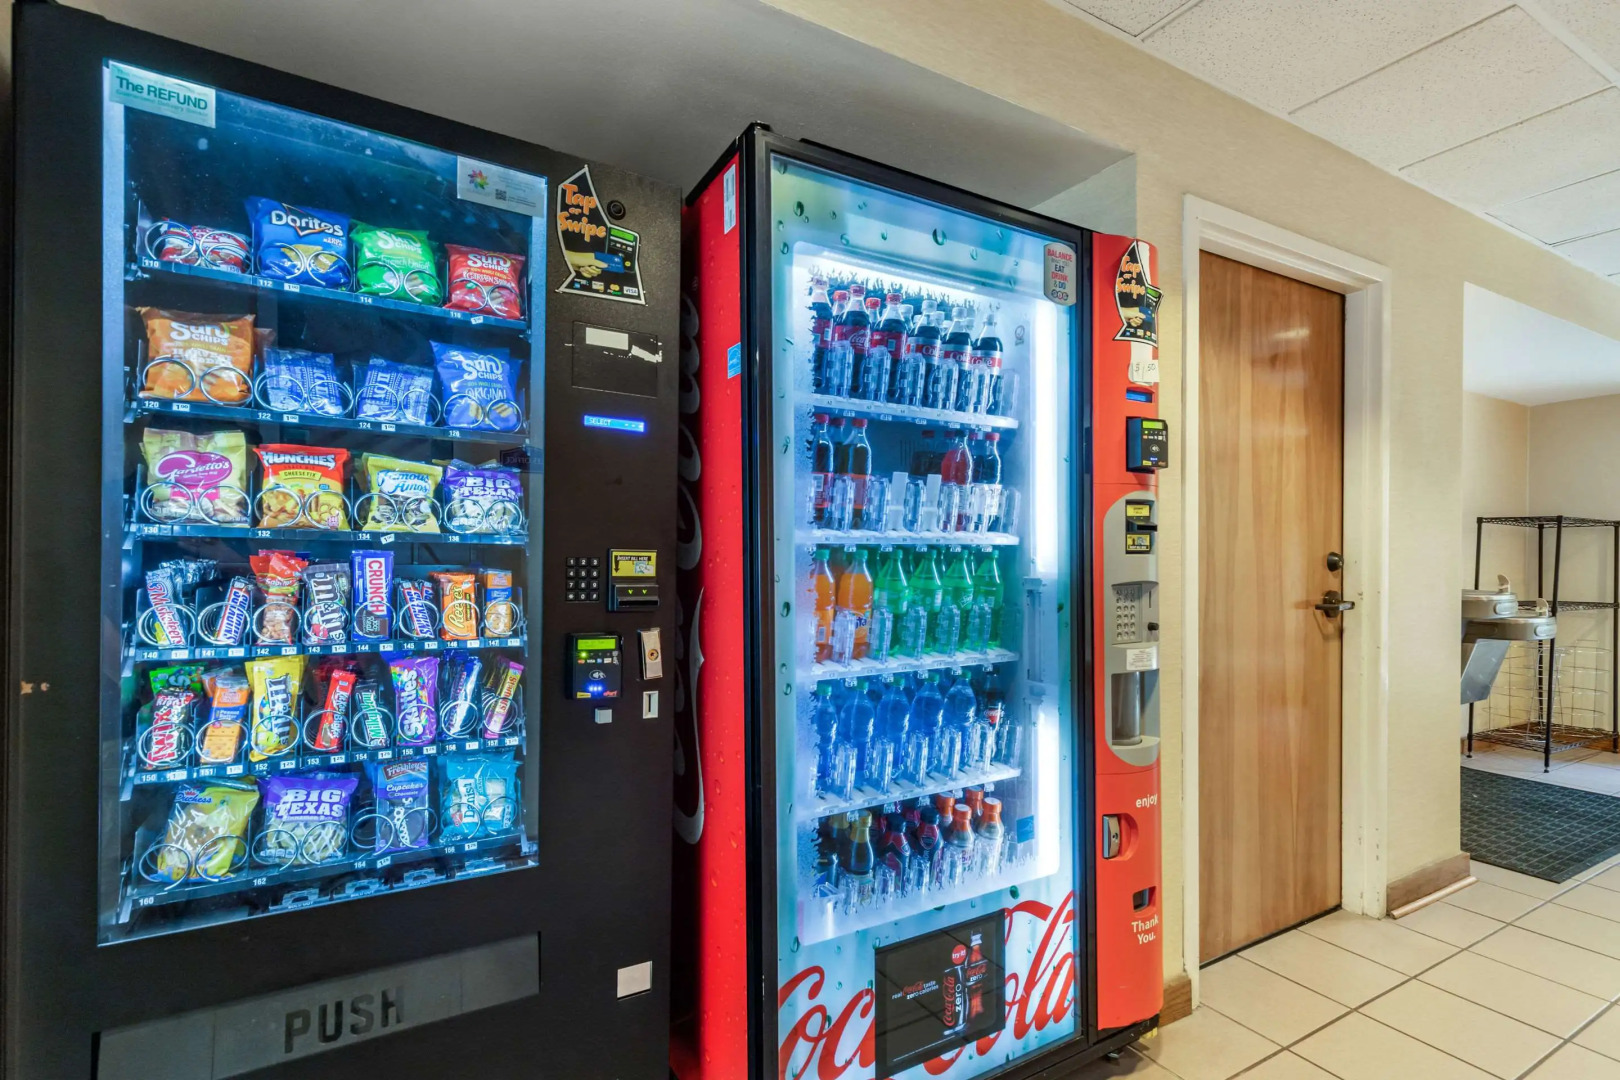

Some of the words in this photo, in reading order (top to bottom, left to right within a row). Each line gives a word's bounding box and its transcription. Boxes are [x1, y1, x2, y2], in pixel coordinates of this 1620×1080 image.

[116, 75, 144, 94] The
[147, 84, 208, 111] REFUND
[562, 183, 597, 215] Tap
[569, 207, 581, 215] or
[271, 210, 343, 236] Doritos
[557, 212, 606, 242] Swipe
[396, 241, 422, 254] CHIPS
[467, 253, 511, 268] Sun
[1047, 248, 1072, 262] BALANCE
[482, 262, 510, 273] CHIPS
[1055, 264, 1065, 273] EAT
[1121, 255, 1141, 279] Tap
[1051, 272, 1069, 282] DRINK
[1058, 282, 1066, 290] DO
[1116, 277, 1146, 299] Swipe
[360, 296, 372, 304] 114
[170, 321, 230, 341] Sun
[191, 333, 229, 346] CHIPS
[462, 358, 503, 380] Sun
[478, 372, 504, 381] CHIPS
[144, 400, 159, 408] 120
[589, 417, 611, 426] SELECT
[261, 450, 336, 470] MUNCHIES
[156, 453, 230, 487] Gardetto's
[377, 469, 430, 487] Famous
[466, 476, 511, 489] BIG
[388, 482, 428, 494] Amos
[459, 487, 517, 500] TEXAS
[368, 559, 383, 614] CRUNCH
[151, 590, 186, 646] Musketeers
[364, 615, 374, 636] Real
[257, 647, 270, 655] 142
[403, 669, 424, 736] Skittles
[147, 708, 177, 768] TWIX
[200, 767, 213, 775] 151
[255, 763, 267, 771] 152
[386, 761, 424, 777] Freshley's
[142, 774, 157, 782] 150
[386, 782, 424, 792] Cupcakes
[176, 792, 212, 804] Duchess
[289, 789, 342, 803] BIG
[462, 782, 477, 819] Danish
[1135, 793, 1158, 808] enjoy
[275, 802, 344, 817] TEXAS
[354, 860, 366, 868] 164
[253, 877, 266, 886] 162
[139, 896, 154, 906] 160
[1131, 914, 1159, 932] Thank
[1137, 931, 1156, 945] You.
[970, 973, 983, 982] zero
[892, 991, 903, 1000] real
[923, 979, 936, 988] taste
[283, 985, 404, 1054] PUSH
